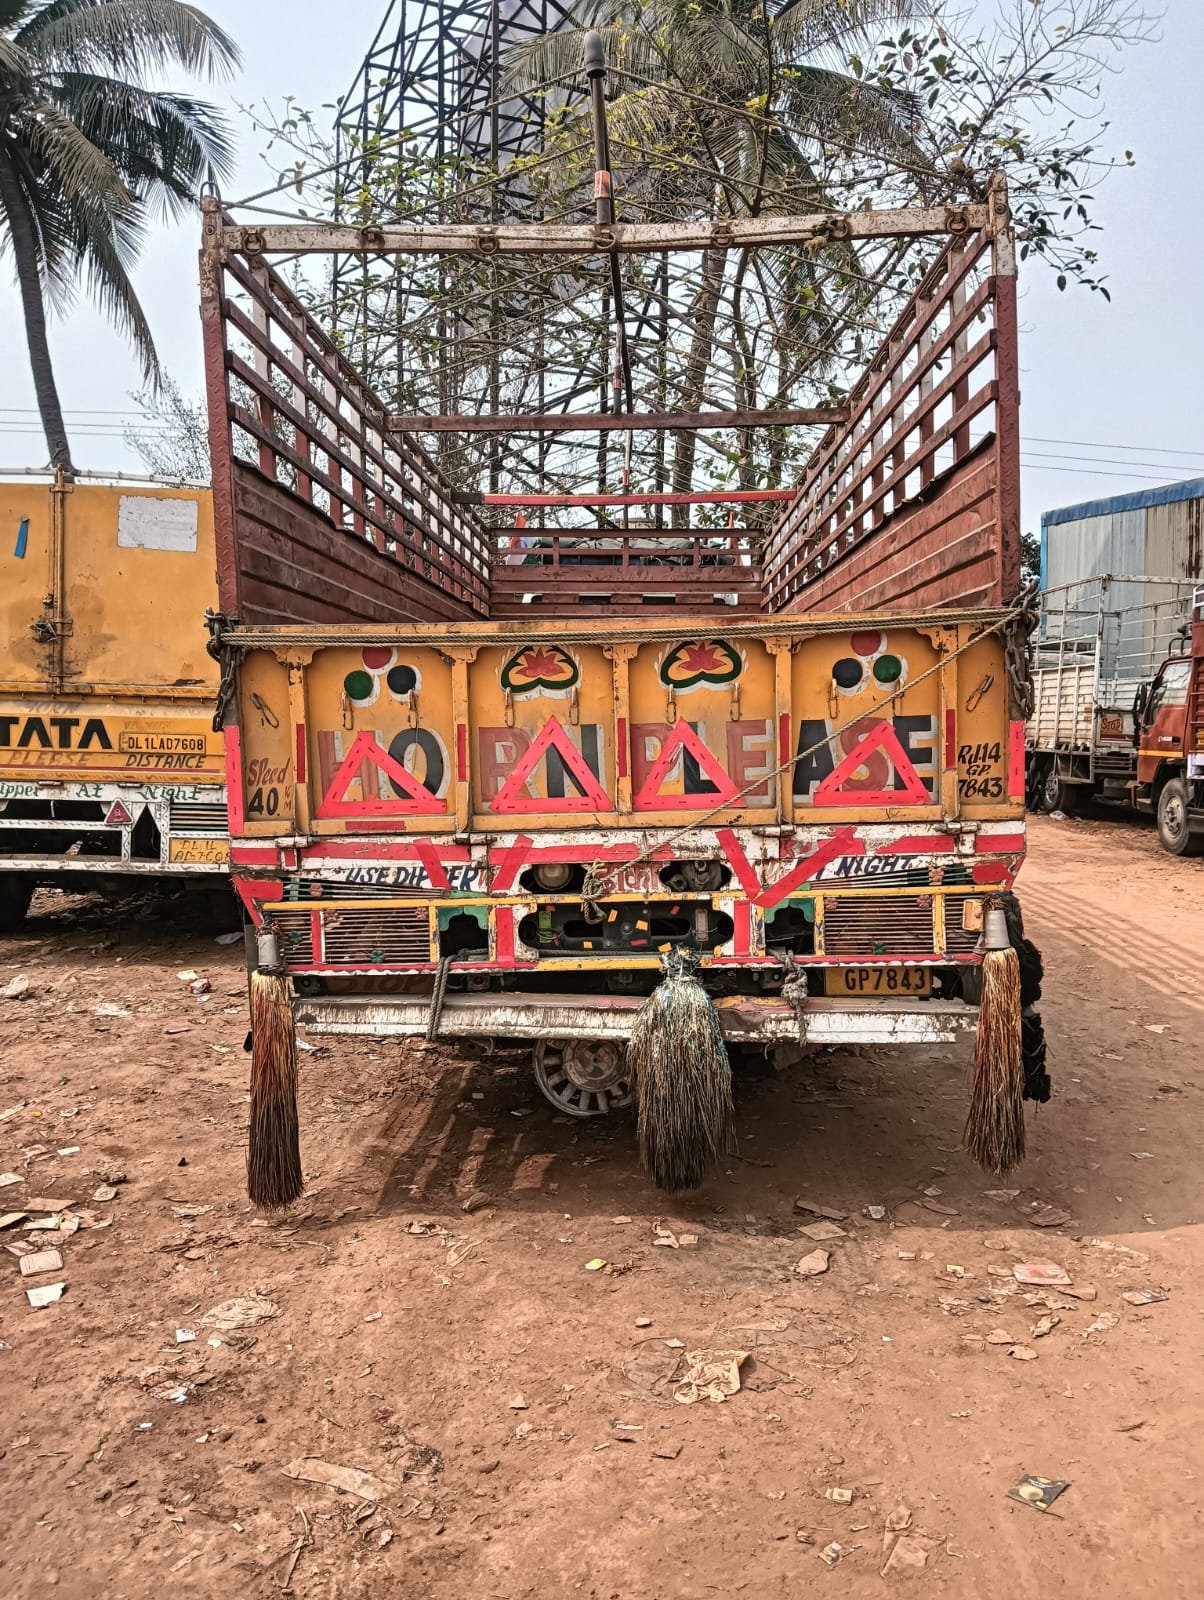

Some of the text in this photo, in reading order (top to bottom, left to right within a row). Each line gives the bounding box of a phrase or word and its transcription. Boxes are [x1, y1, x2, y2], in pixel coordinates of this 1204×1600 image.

[0, 716, 113, 749] TATA
[128, 736, 204, 750] DL1LAD7608
[126, 754, 205, 769] DISTANCE
[0, 782, 41, 798] ipper
[958, 777, 1003, 798] 7843
[345, 865, 390, 885] USE
[392, 865, 479, 891] DIPER
[844, 968, 926, 991] GP7843
